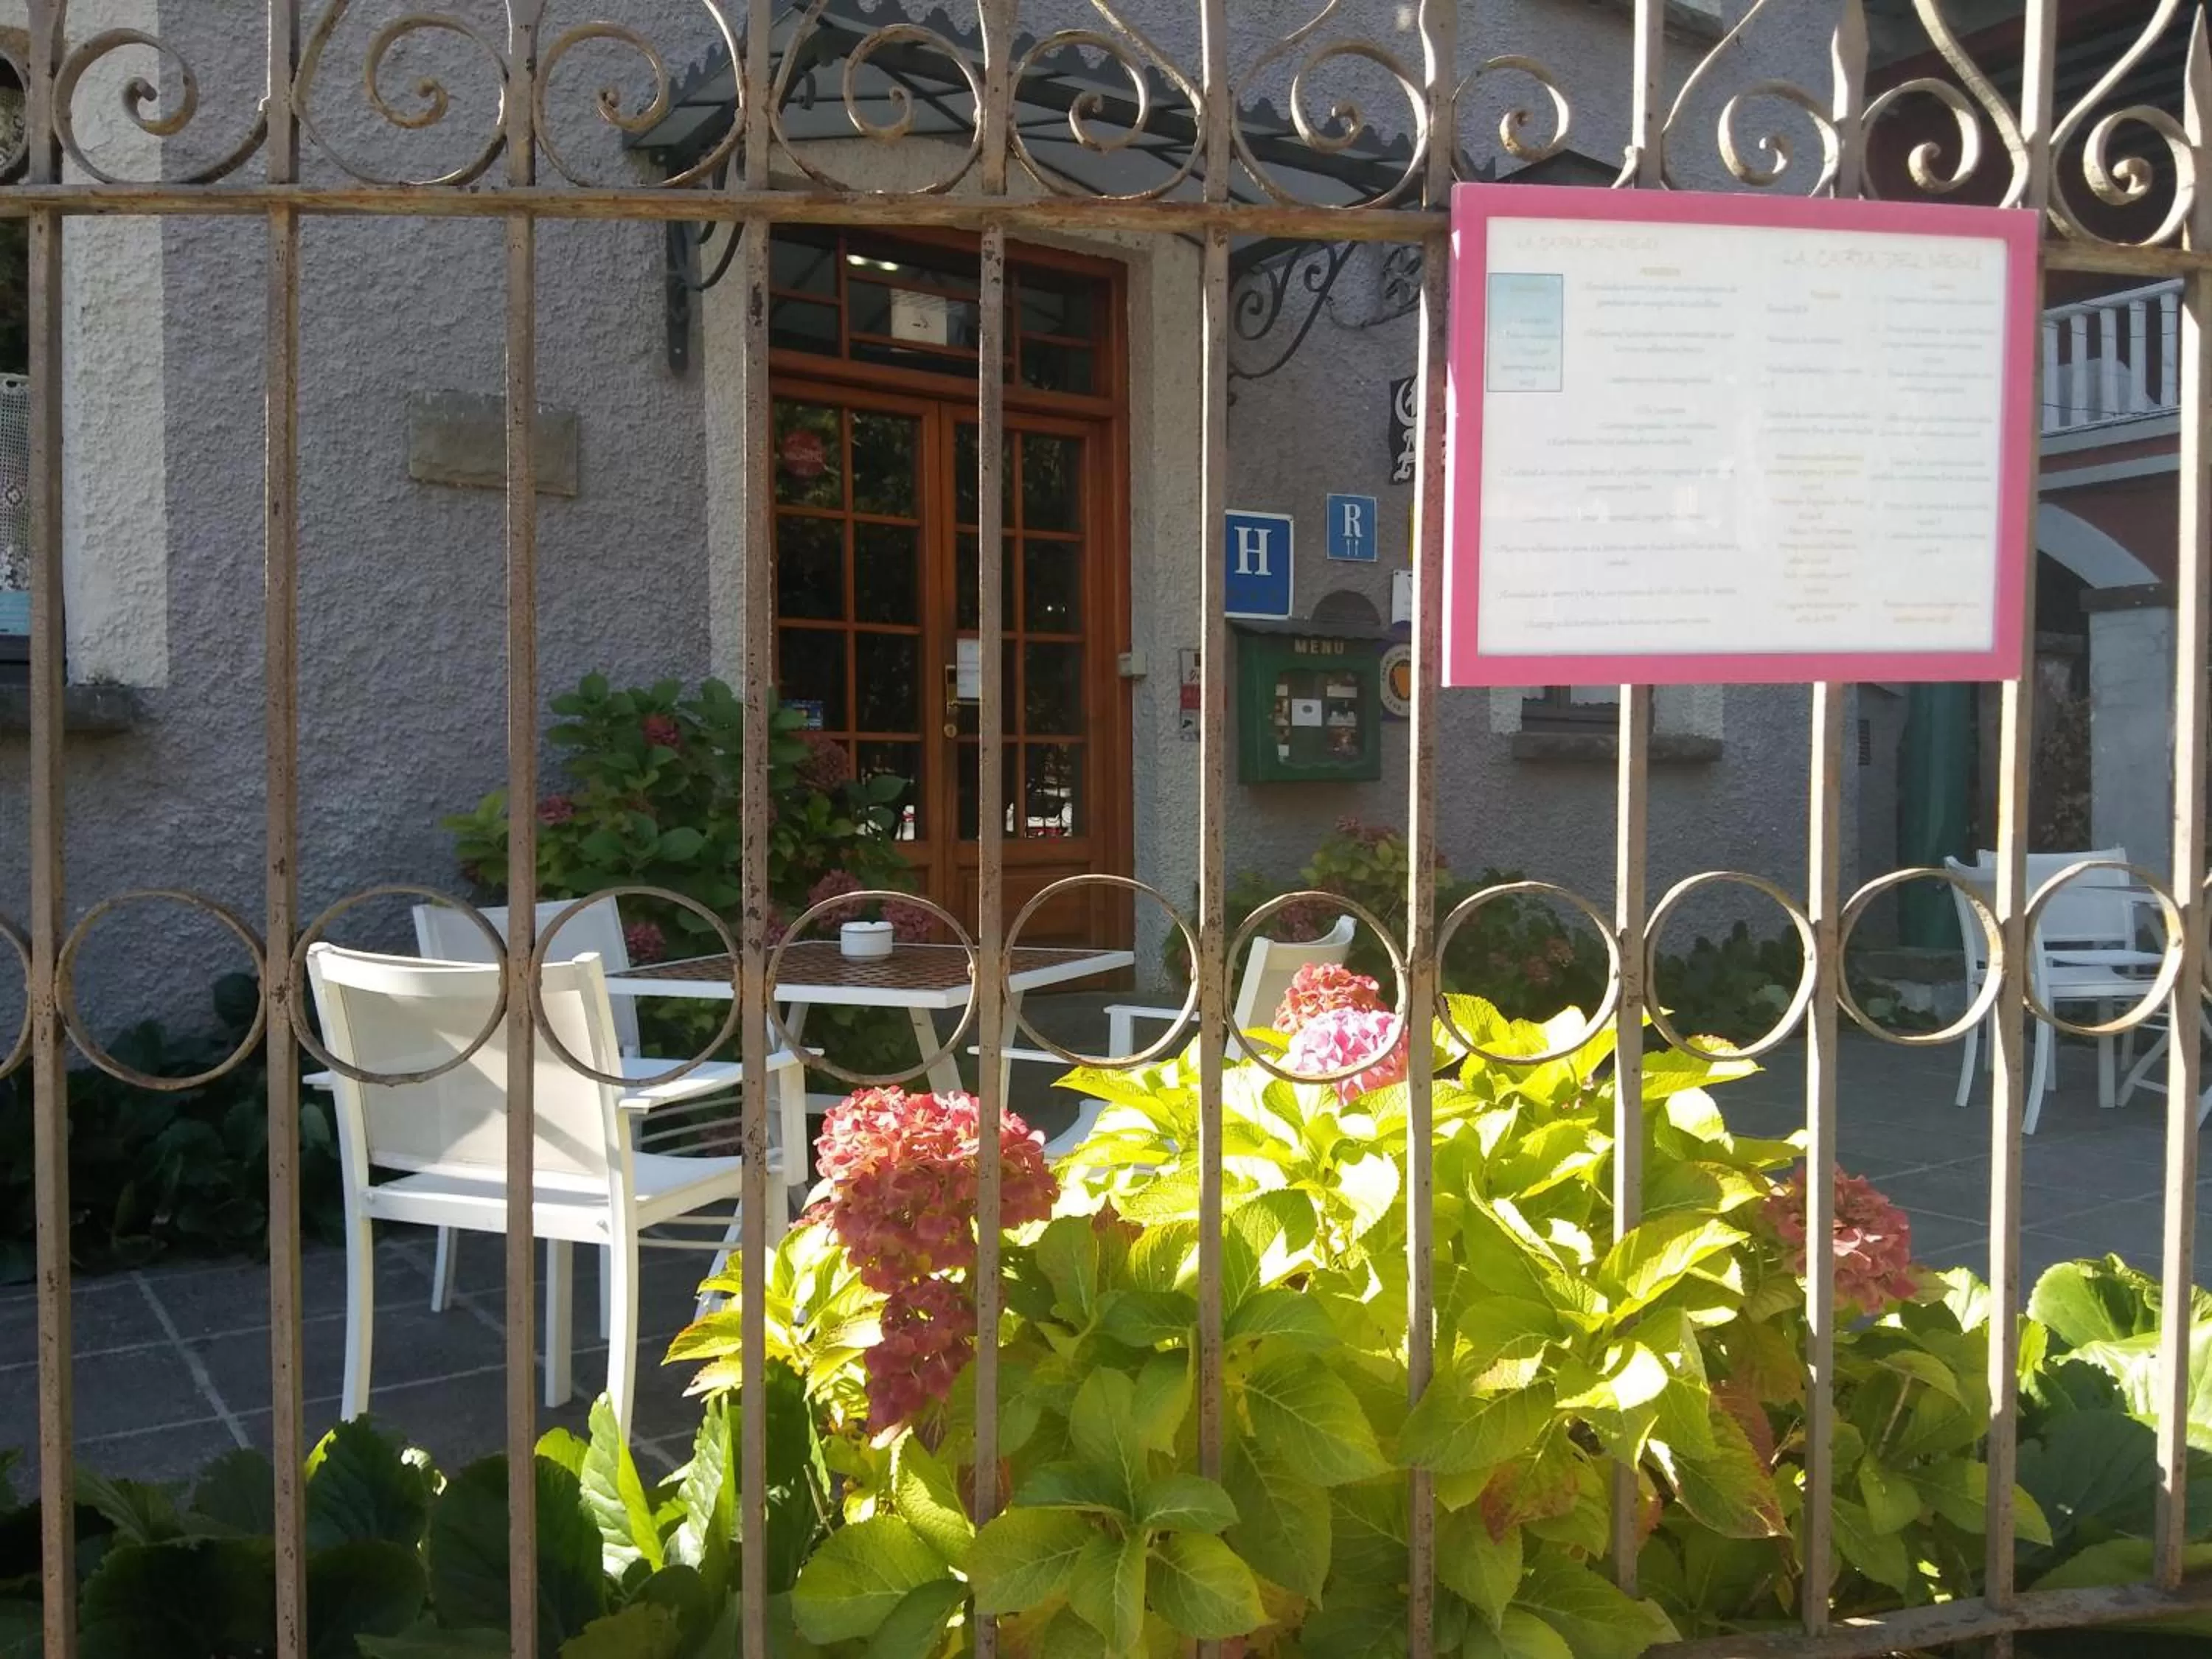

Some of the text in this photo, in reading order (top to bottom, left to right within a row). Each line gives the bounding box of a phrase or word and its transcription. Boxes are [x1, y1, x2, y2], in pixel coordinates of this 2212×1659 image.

[1342, 504, 1363, 538] R
[1234, 526, 1272, 576] H
[1294, 639, 1345, 655] MENU
